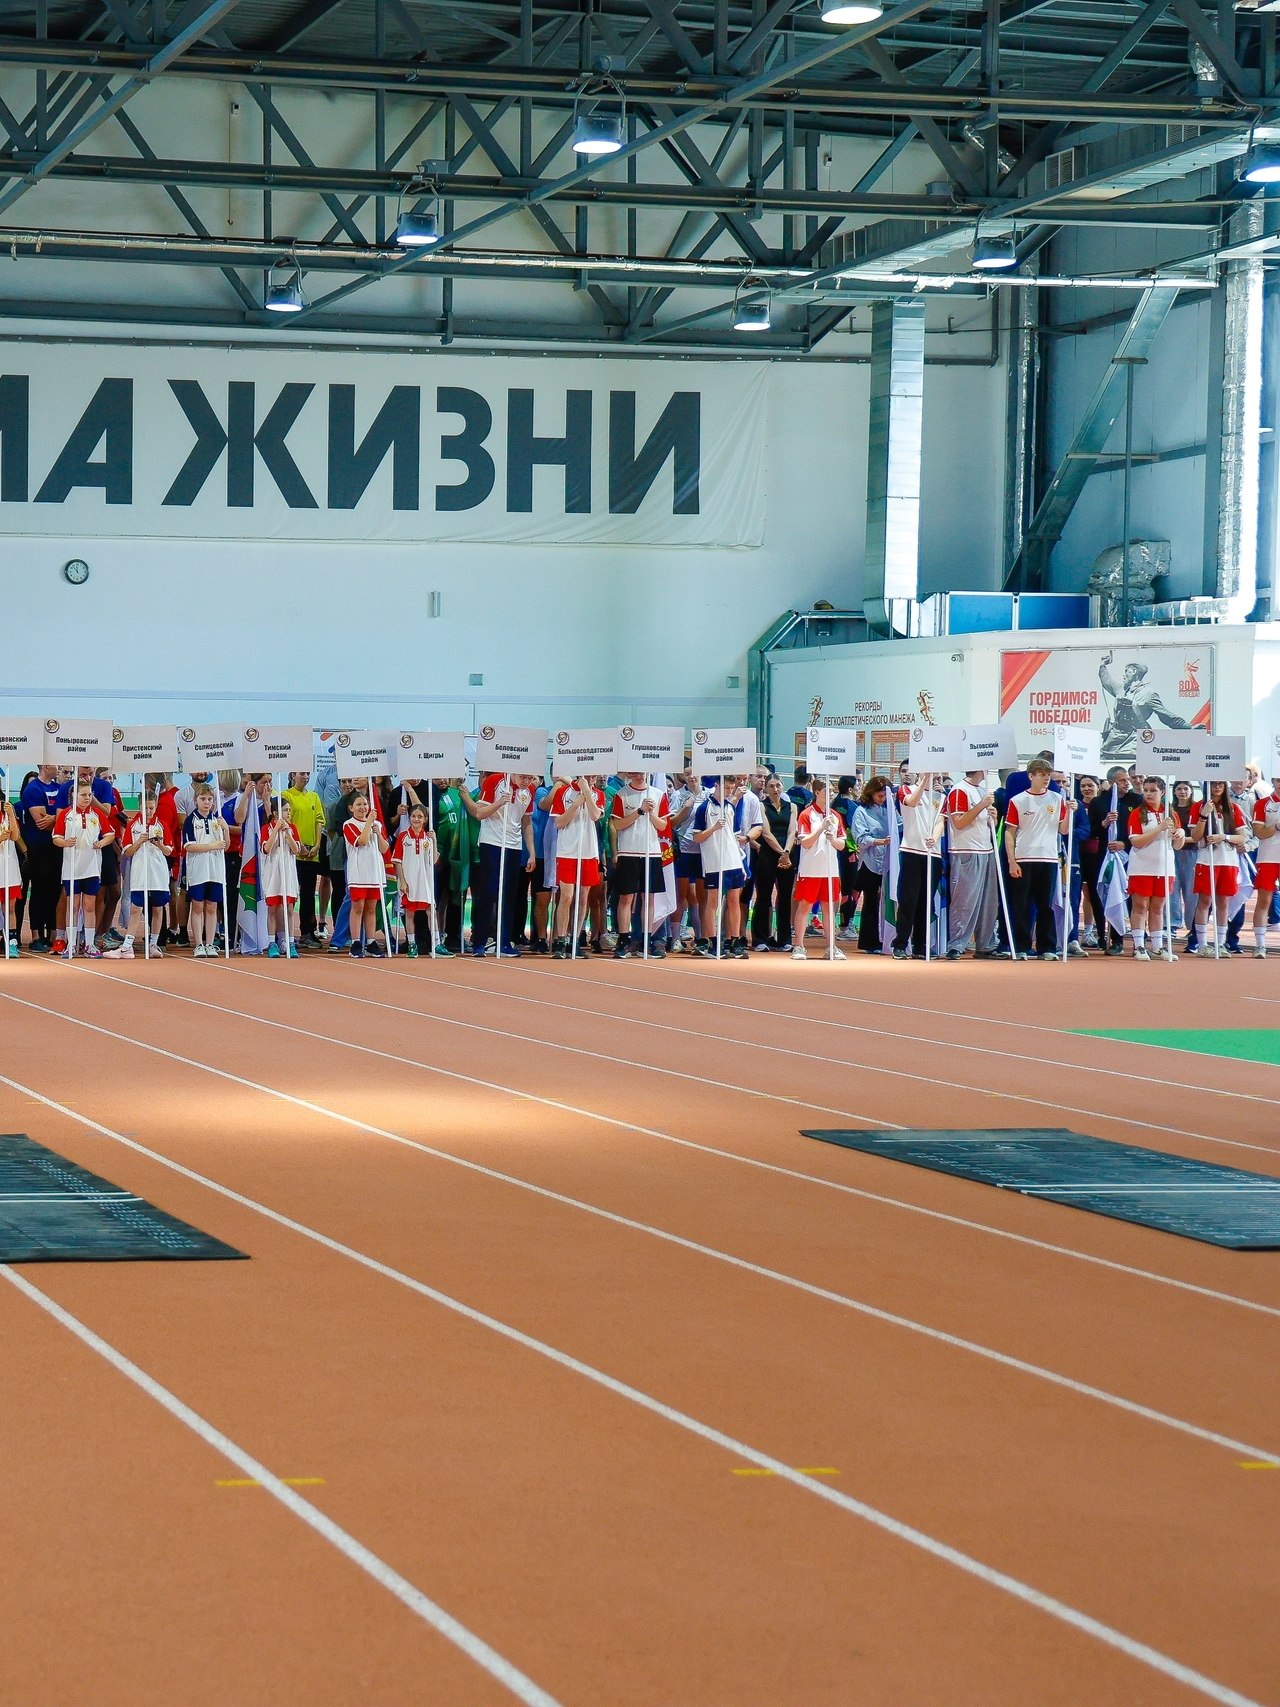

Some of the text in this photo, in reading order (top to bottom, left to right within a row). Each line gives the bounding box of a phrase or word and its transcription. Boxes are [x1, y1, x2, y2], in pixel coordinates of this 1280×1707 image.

[161, 379, 701, 514] ЖИЗНИ
[1029, 690, 1098, 708] ГОРДИМСЯ
[854, 701, 882, 712] РЕКОРДЫ
[824, 714, 916, 726] ЛЕГКОАТЛЕТИЧЕСКОГО МАНЕЖА
[1029, 708, 1091, 725] ПОБЕДОЙ!
[56, 736, 98, 744] Поныровский
[122, 744, 162, 752] Пристенский
[194, 740, 234, 751] Солнцевский
[495, 744, 528, 752] Беловский
[632, 744, 670, 752] Глушковский
[206, 750, 224, 758] район
[350, 748, 386, 757] Щигровский
[558, 746, 614, 754] Большесолдатский
[1152, 746, 1190, 754] Суджанский
[134, 752, 152, 760] район
[360, 756, 378, 764] район
[423, 752, 444, 760] Щигры
[502, 752, 520, 760] район
[576, 754, 594, 762] район
[716, 754, 733, 762] район
